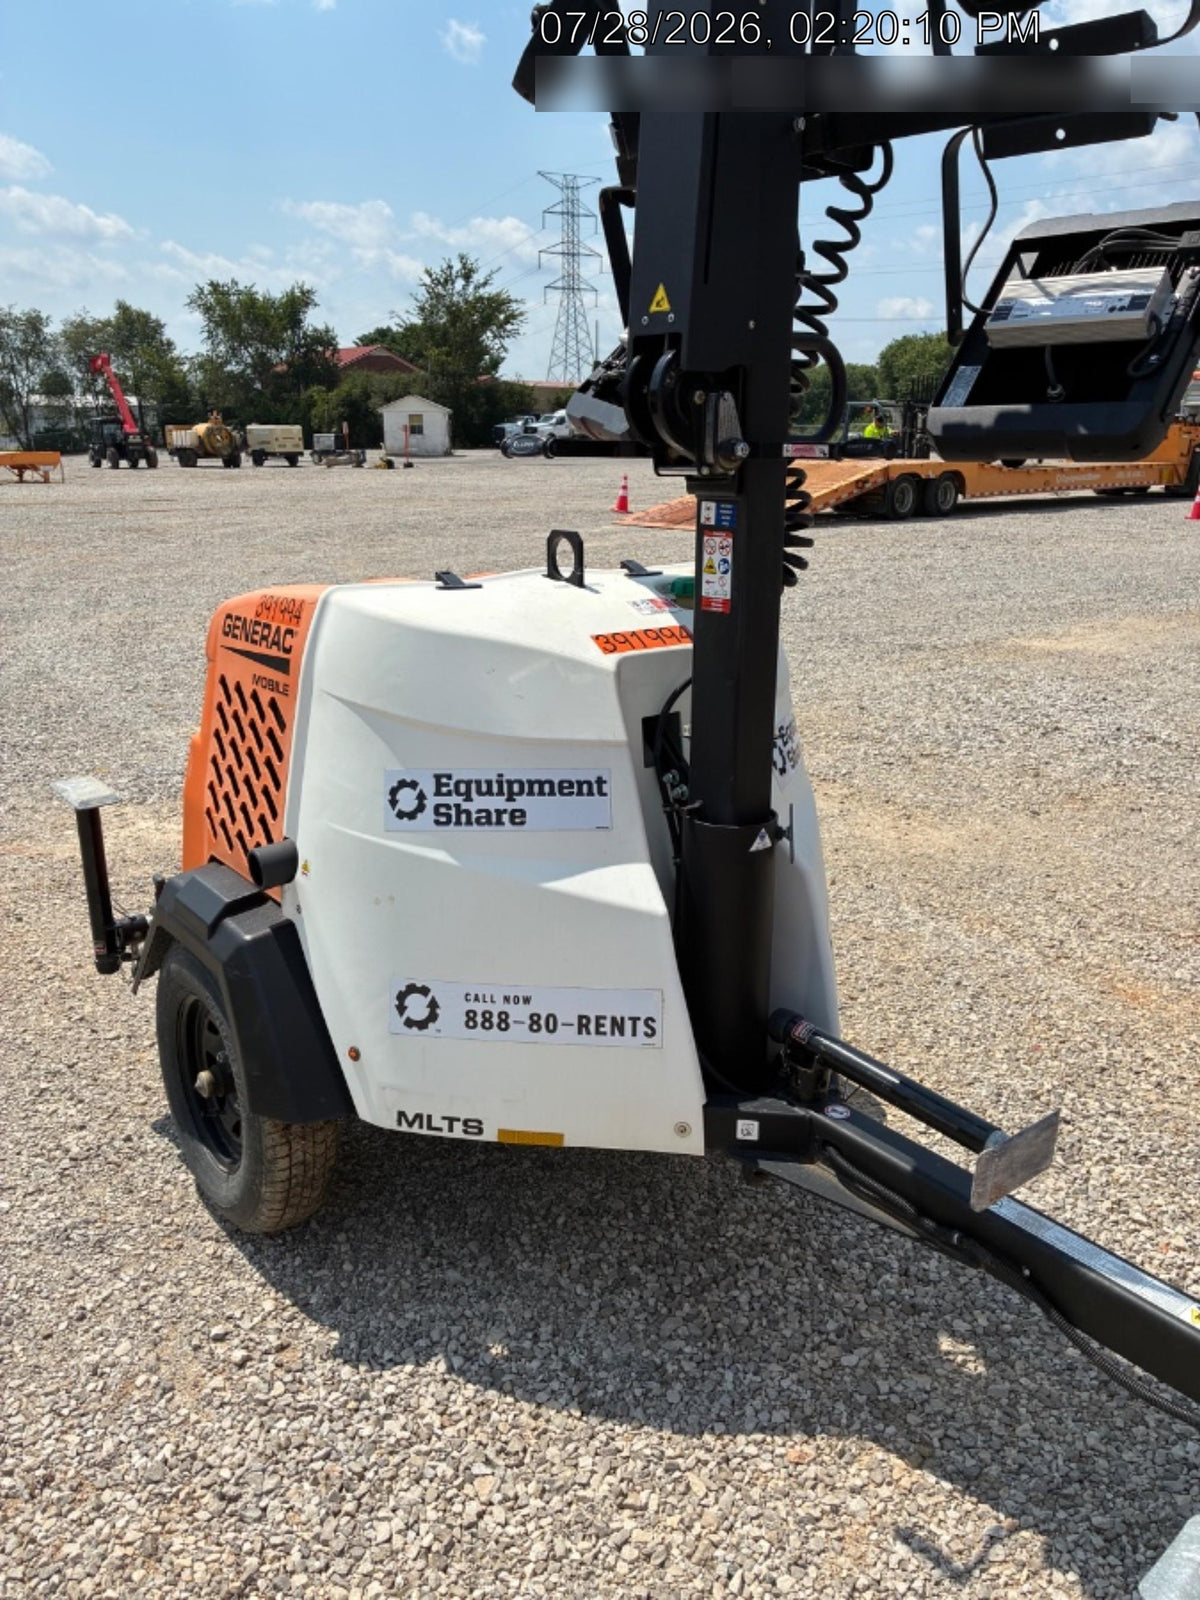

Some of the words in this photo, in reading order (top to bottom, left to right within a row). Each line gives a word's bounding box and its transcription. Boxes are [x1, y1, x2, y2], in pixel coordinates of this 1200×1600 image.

[222, 613, 294, 655] GENERAC
[251, 673, 290, 697] MOBILE
[433, 773, 608, 802] Equipment
[433, 803, 527, 827] Share
[464, 992, 496, 1004] CALL
[503, 994, 533, 1006] NOW
[464, 1009, 657, 1039] 888-80-RENTS
[396, 1110, 484, 1136] MLTS
